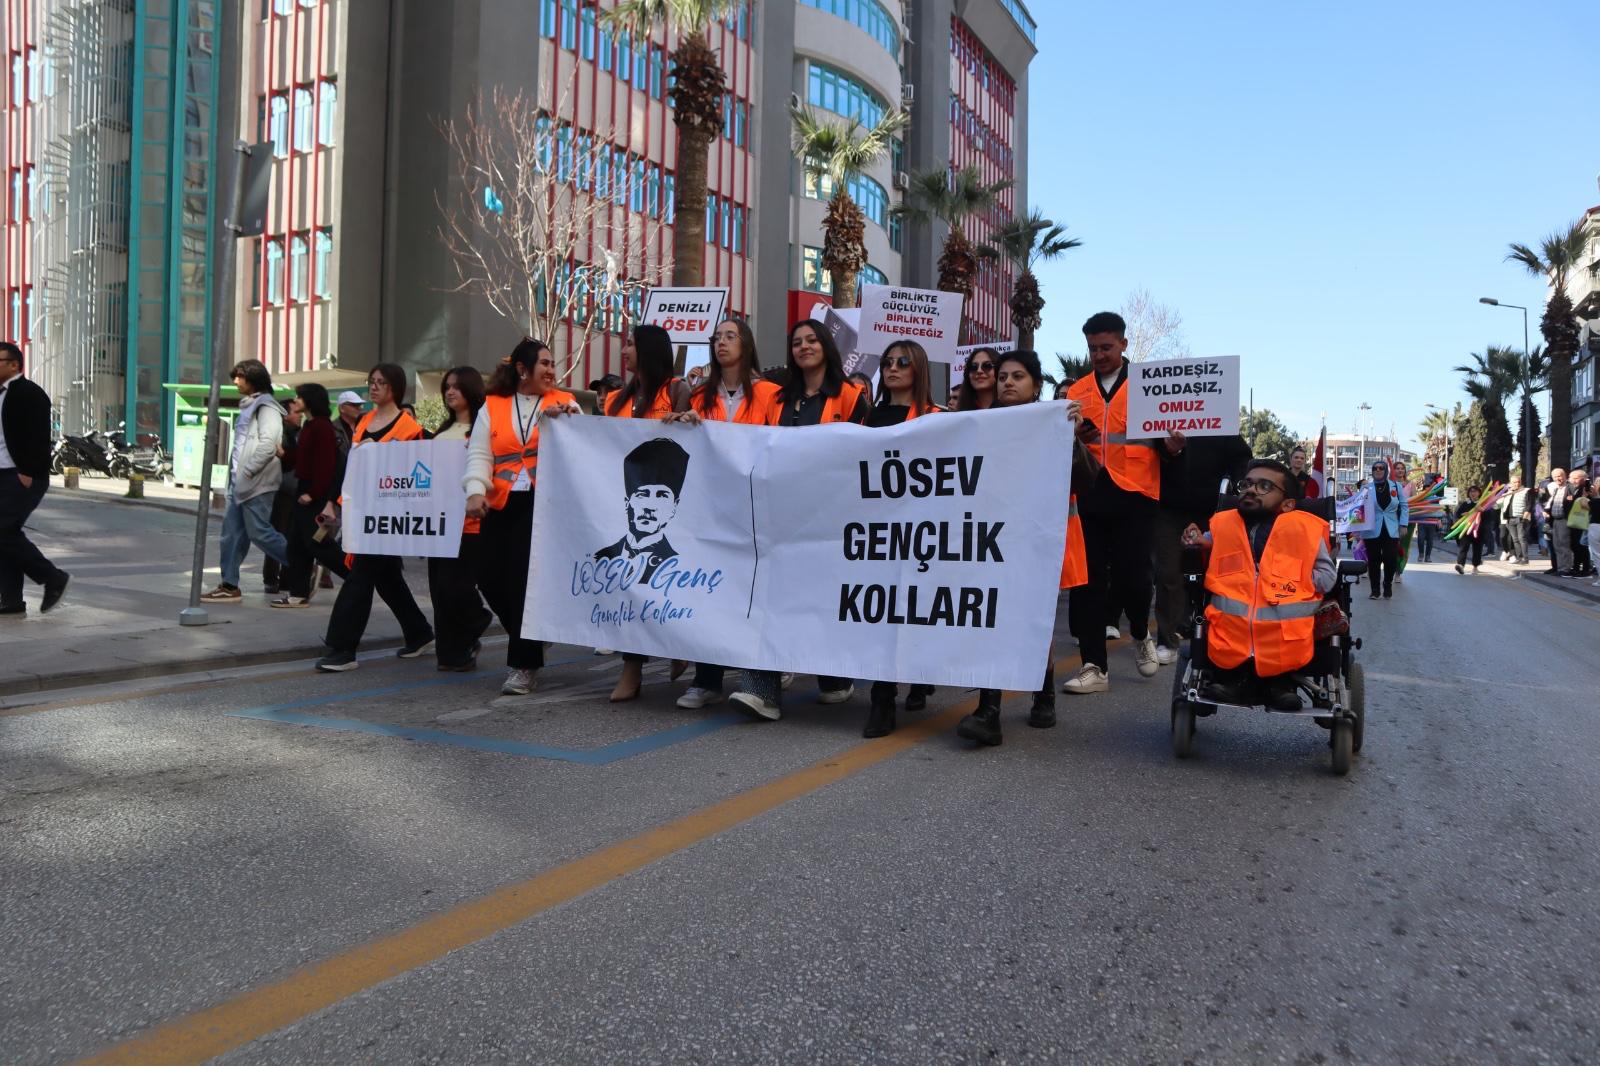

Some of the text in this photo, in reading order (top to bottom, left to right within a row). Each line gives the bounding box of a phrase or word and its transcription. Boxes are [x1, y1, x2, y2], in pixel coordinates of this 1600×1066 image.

[891, 290, 938, 303] BİRLİKTE
[658, 301, 712, 313] DENİZLİ
[882, 301, 940, 316] GÜÇLÜYÜZ,
[886, 313, 934, 326] BİRLİKTE
[874, 322, 943, 338] İYİLEŞECEĞİZ
[1142, 361, 1223, 379] KARDEŞİZ,
[1142, 381, 1222, 397] YOLDAŞIZ,
[1158, 400, 1205, 413] OMUZ
[1142, 417, 1222, 432] OMUZAYIZ
[379, 475, 414, 489] LÖSEV
[859, 450, 984, 499] LÖSEV
[364, 512, 446, 536] DENİZLİ
[843, 511, 1005, 572] GENÇLİK
[571, 553, 724, 597] LÖSEV Genç
[590, 599, 694, 628] Gençlik Kolları
[838, 584, 999, 629] KOLLARI
